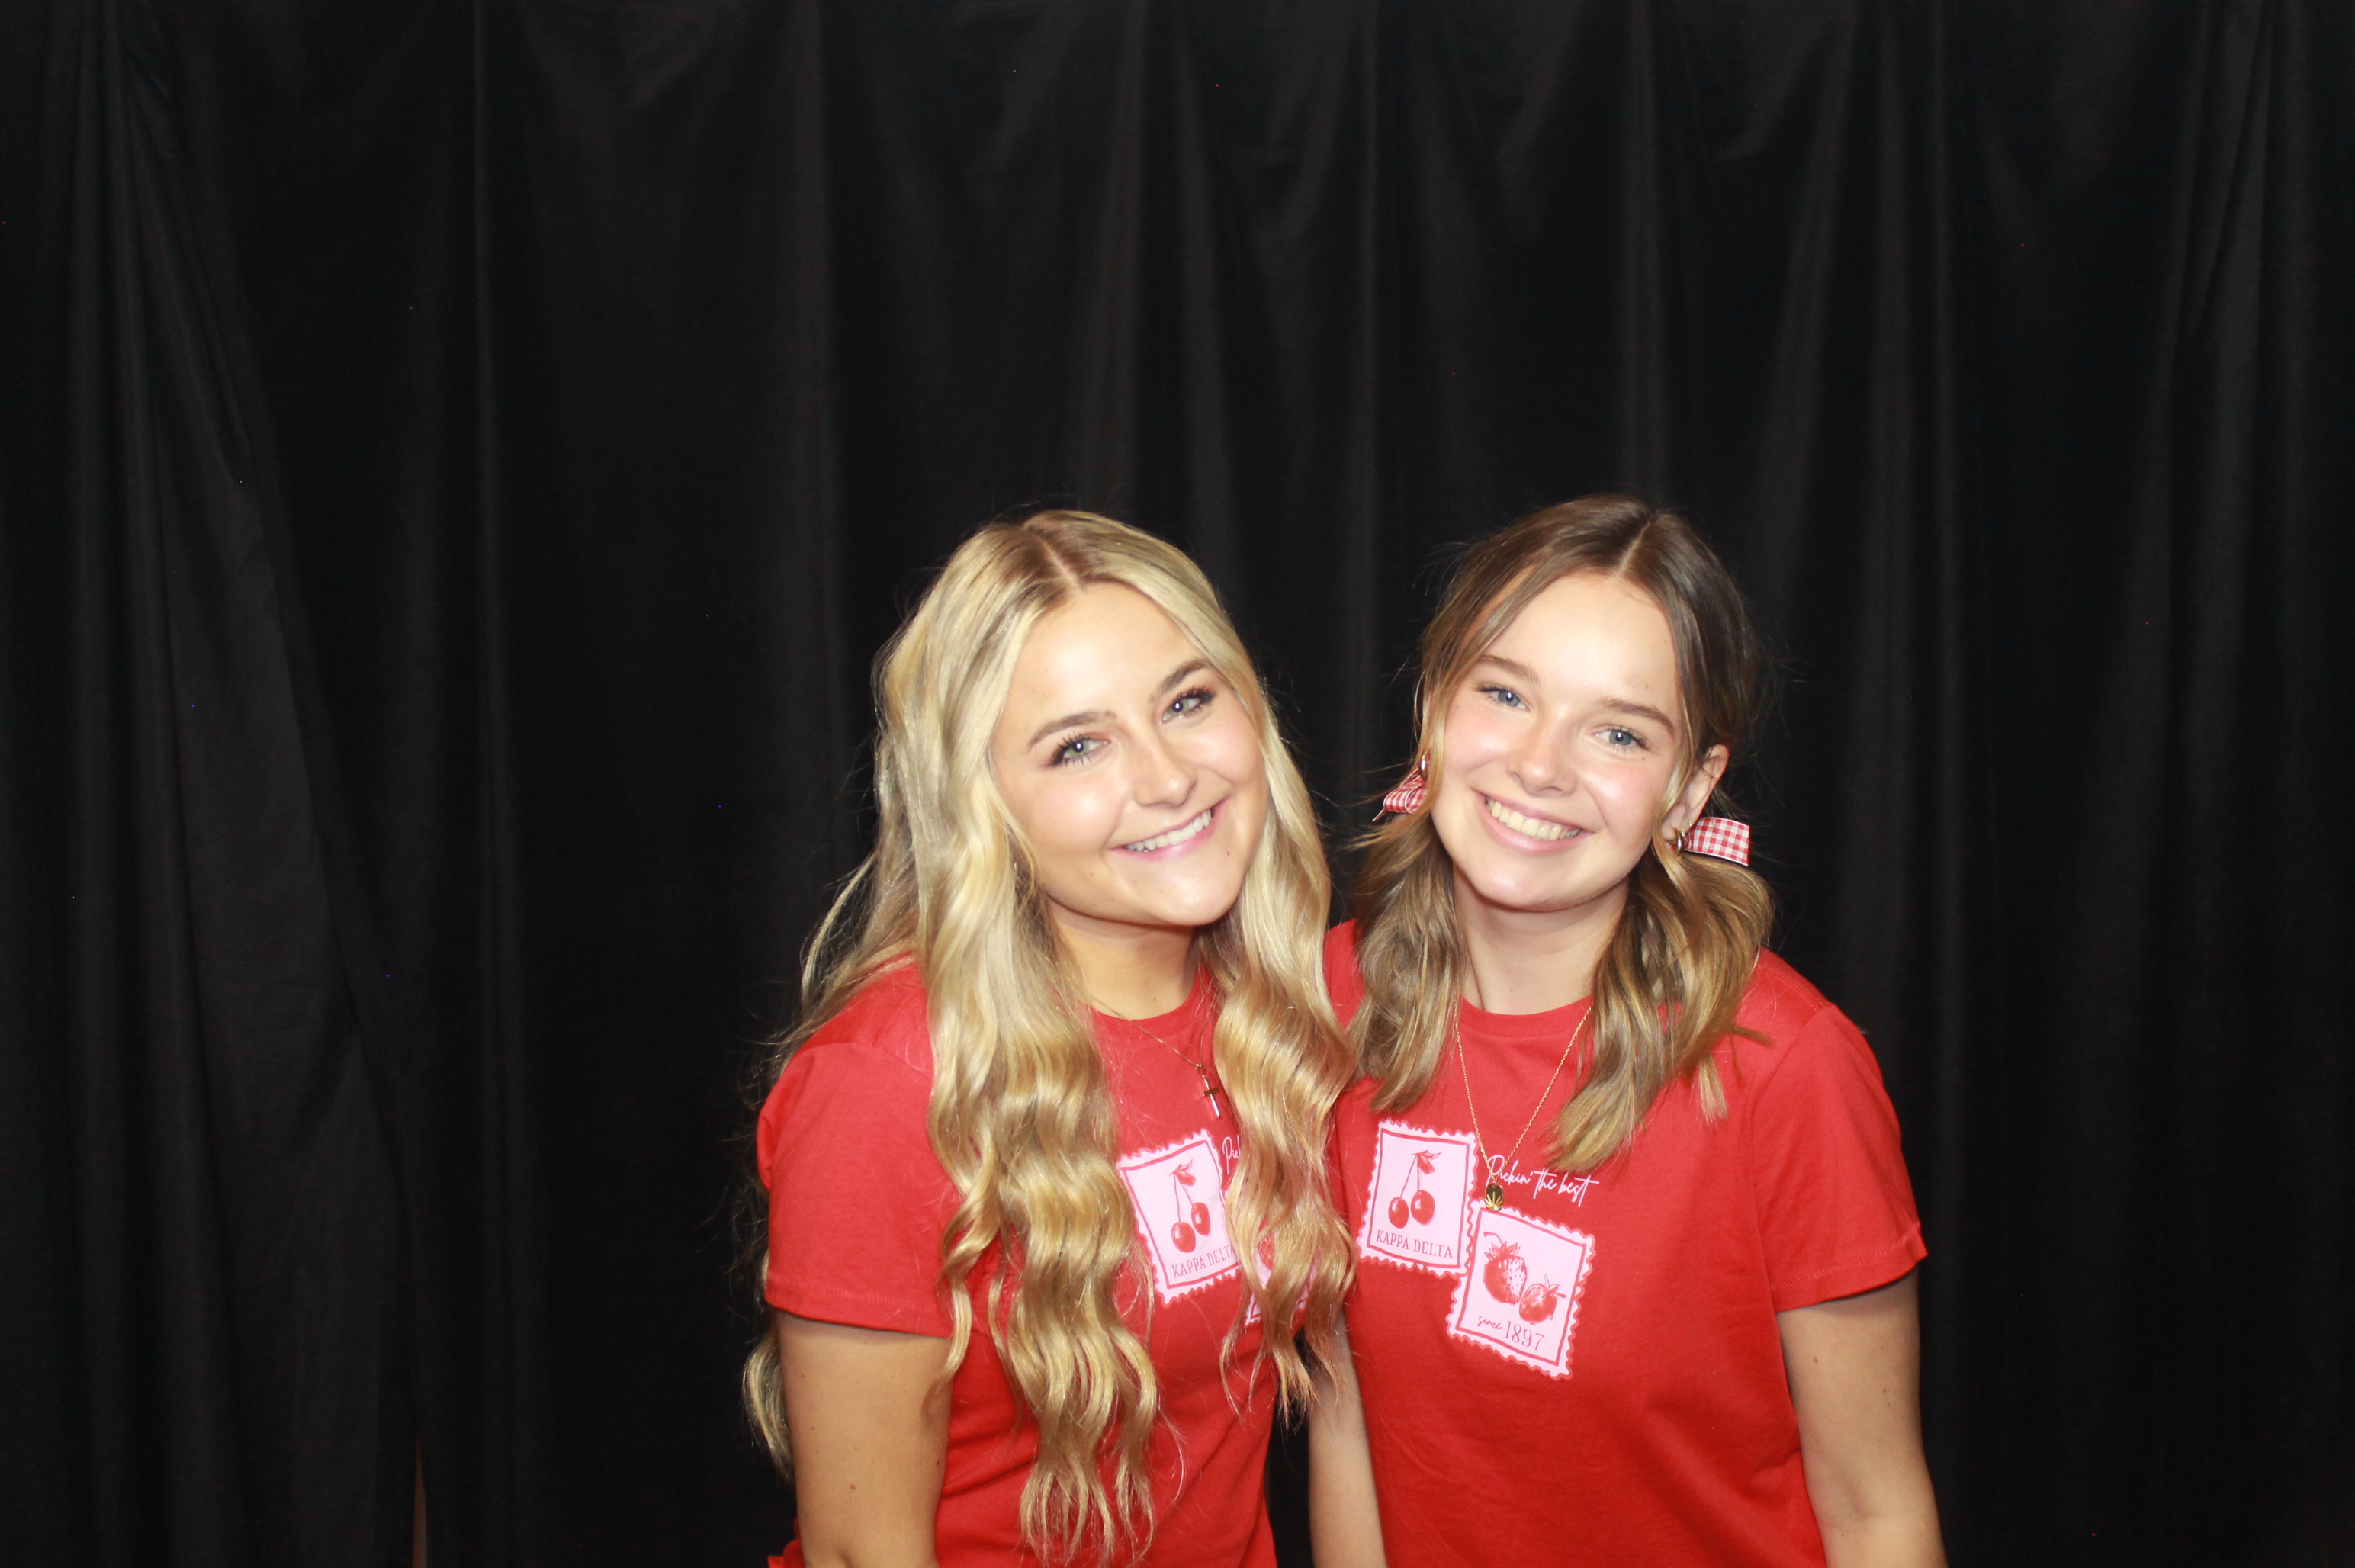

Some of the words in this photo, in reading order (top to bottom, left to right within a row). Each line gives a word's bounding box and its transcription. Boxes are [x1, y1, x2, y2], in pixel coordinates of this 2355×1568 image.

[1557, 1171, 1600, 1207] best
[1171, 1255, 1206, 1279] KAPPA
[1206, 1244, 1237, 1266] DELTA
[1375, 1229, 1410, 1251] KAPPA
[1413, 1238, 1454, 1259] DELTA
[1476, 1316, 1503, 1331] since
[1505, 1320, 1545, 1351] 1897
